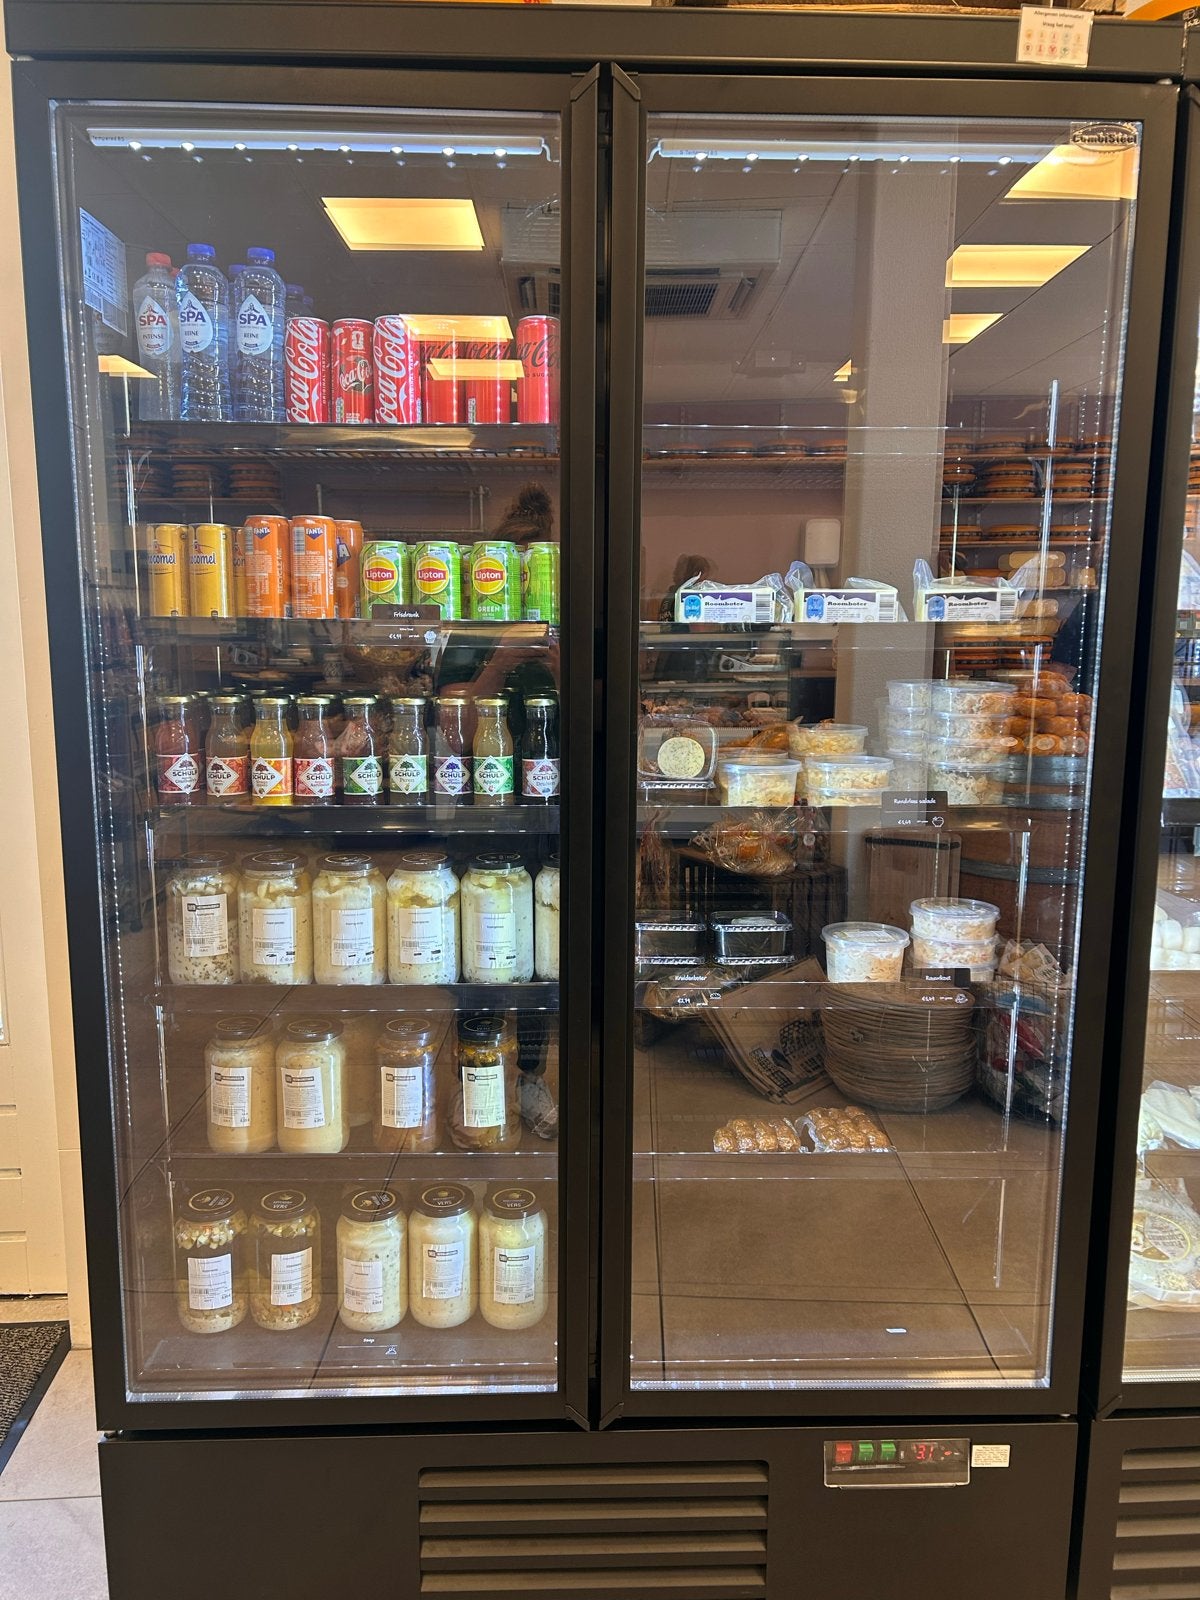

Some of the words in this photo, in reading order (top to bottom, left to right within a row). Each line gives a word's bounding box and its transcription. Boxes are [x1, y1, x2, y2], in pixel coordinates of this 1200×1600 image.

[1072, 133, 1137, 144] CombiSteel
[139, 313, 167, 326] SPA
[180, 310, 207, 323] SPA
[239, 313, 267, 326] SPA
[306, 527, 324, 535] FANTA
[328, 549, 333, 561] ME
[366, 570, 392, 581] Lipton
[418, 570, 444, 581] Lipton
[475, 570, 501, 582] Lipton
[173, 769, 198, 777] SCHULP
[533, 774, 558, 782] SCHULP
